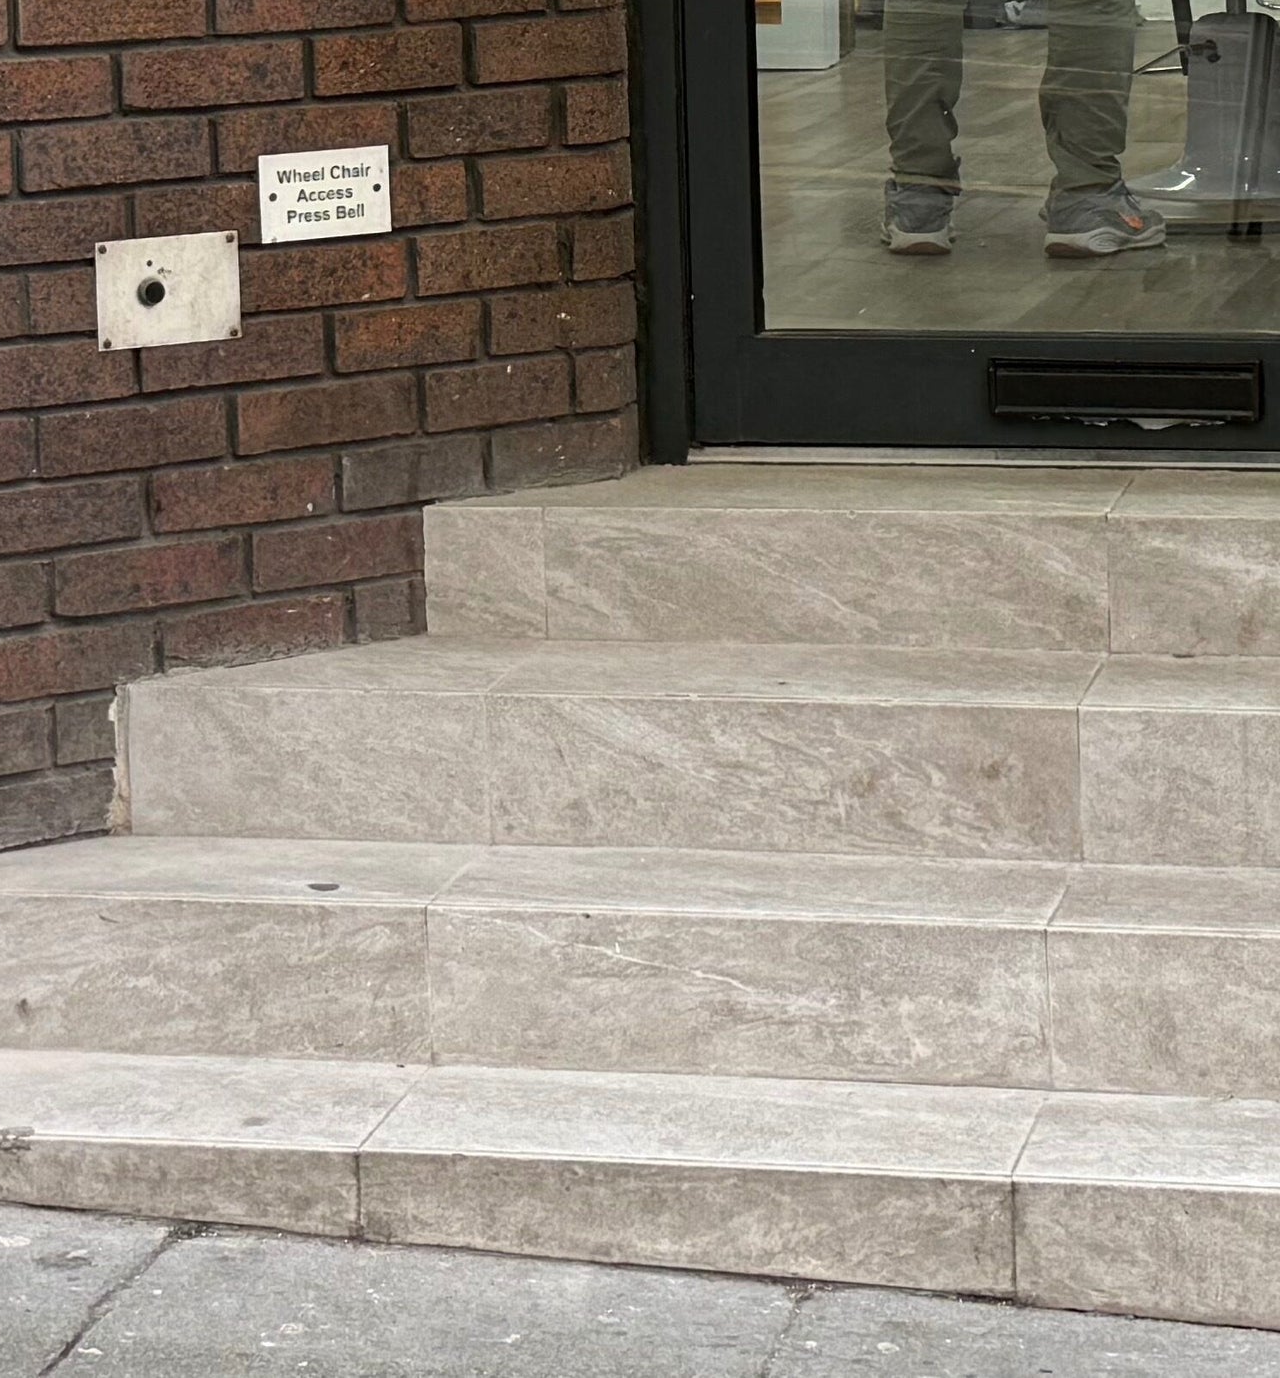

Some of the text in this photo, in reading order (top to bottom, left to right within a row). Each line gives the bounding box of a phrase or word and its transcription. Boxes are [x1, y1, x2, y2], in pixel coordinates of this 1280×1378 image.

[277, 163, 372, 184] Wheel Chair
[296, 186, 354, 203] Access
[286, 203, 366, 224] Press Bell
